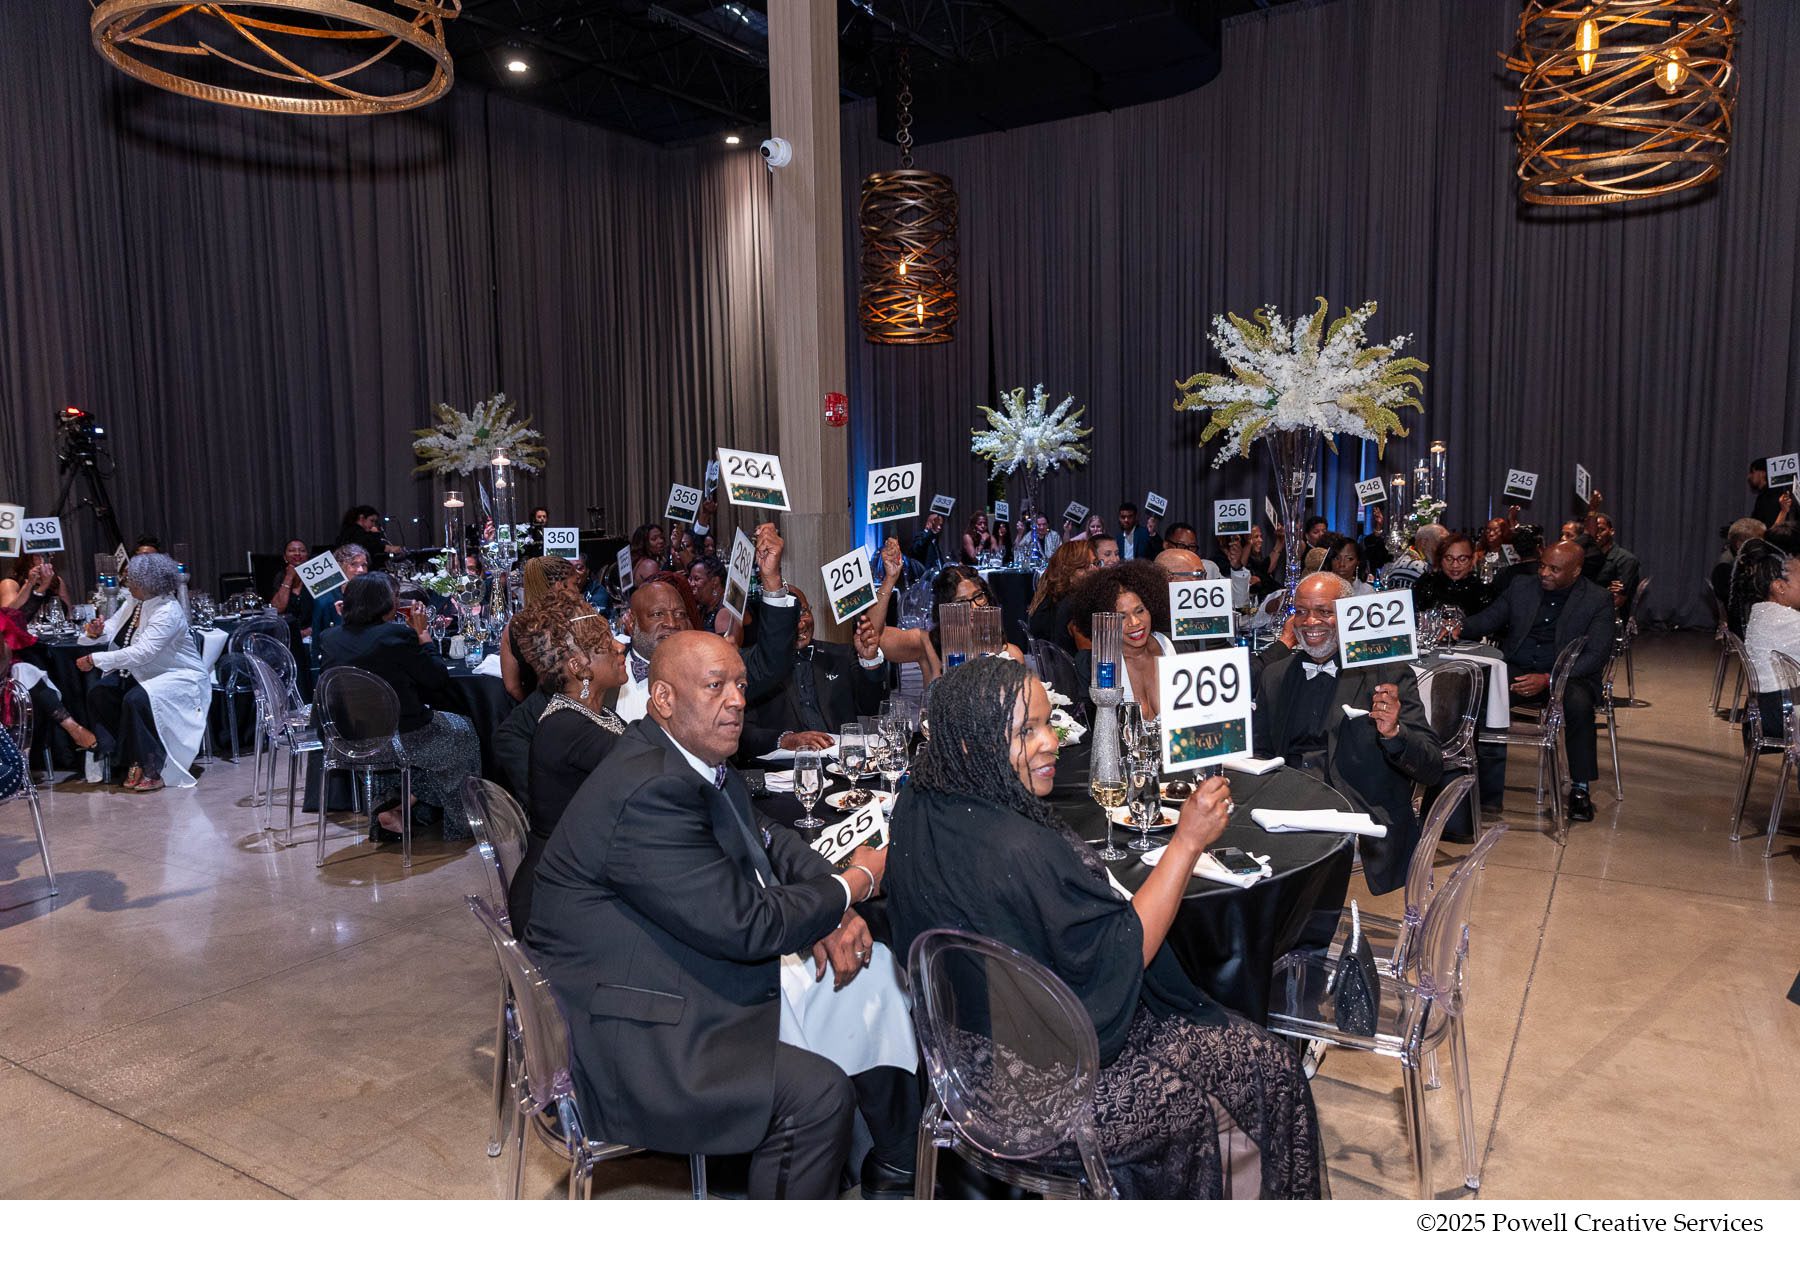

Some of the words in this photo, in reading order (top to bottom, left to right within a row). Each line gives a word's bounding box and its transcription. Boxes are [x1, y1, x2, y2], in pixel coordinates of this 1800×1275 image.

[728, 455, 776, 481] 264
[1770, 457, 1796, 472] 176
[873, 470, 915, 495] 260
[1359, 480, 1380, 494] 248
[1510, 472, 1534, 487] 245
[673, 488, 698, 506] 359
[1219, 503, 1247, 518] 256
[25, 521, 57, 535] 436
[547, 531, 575, 544] 350
[302, 557, 333, 580] 354
[830, 556, 864, 592] 261
[1177, 586, 1225, 610] 266
[1346, 600, 1406, 632] 262
[1172, 662, 1240, 711] 269
[818, 809, 873, 860] 265
